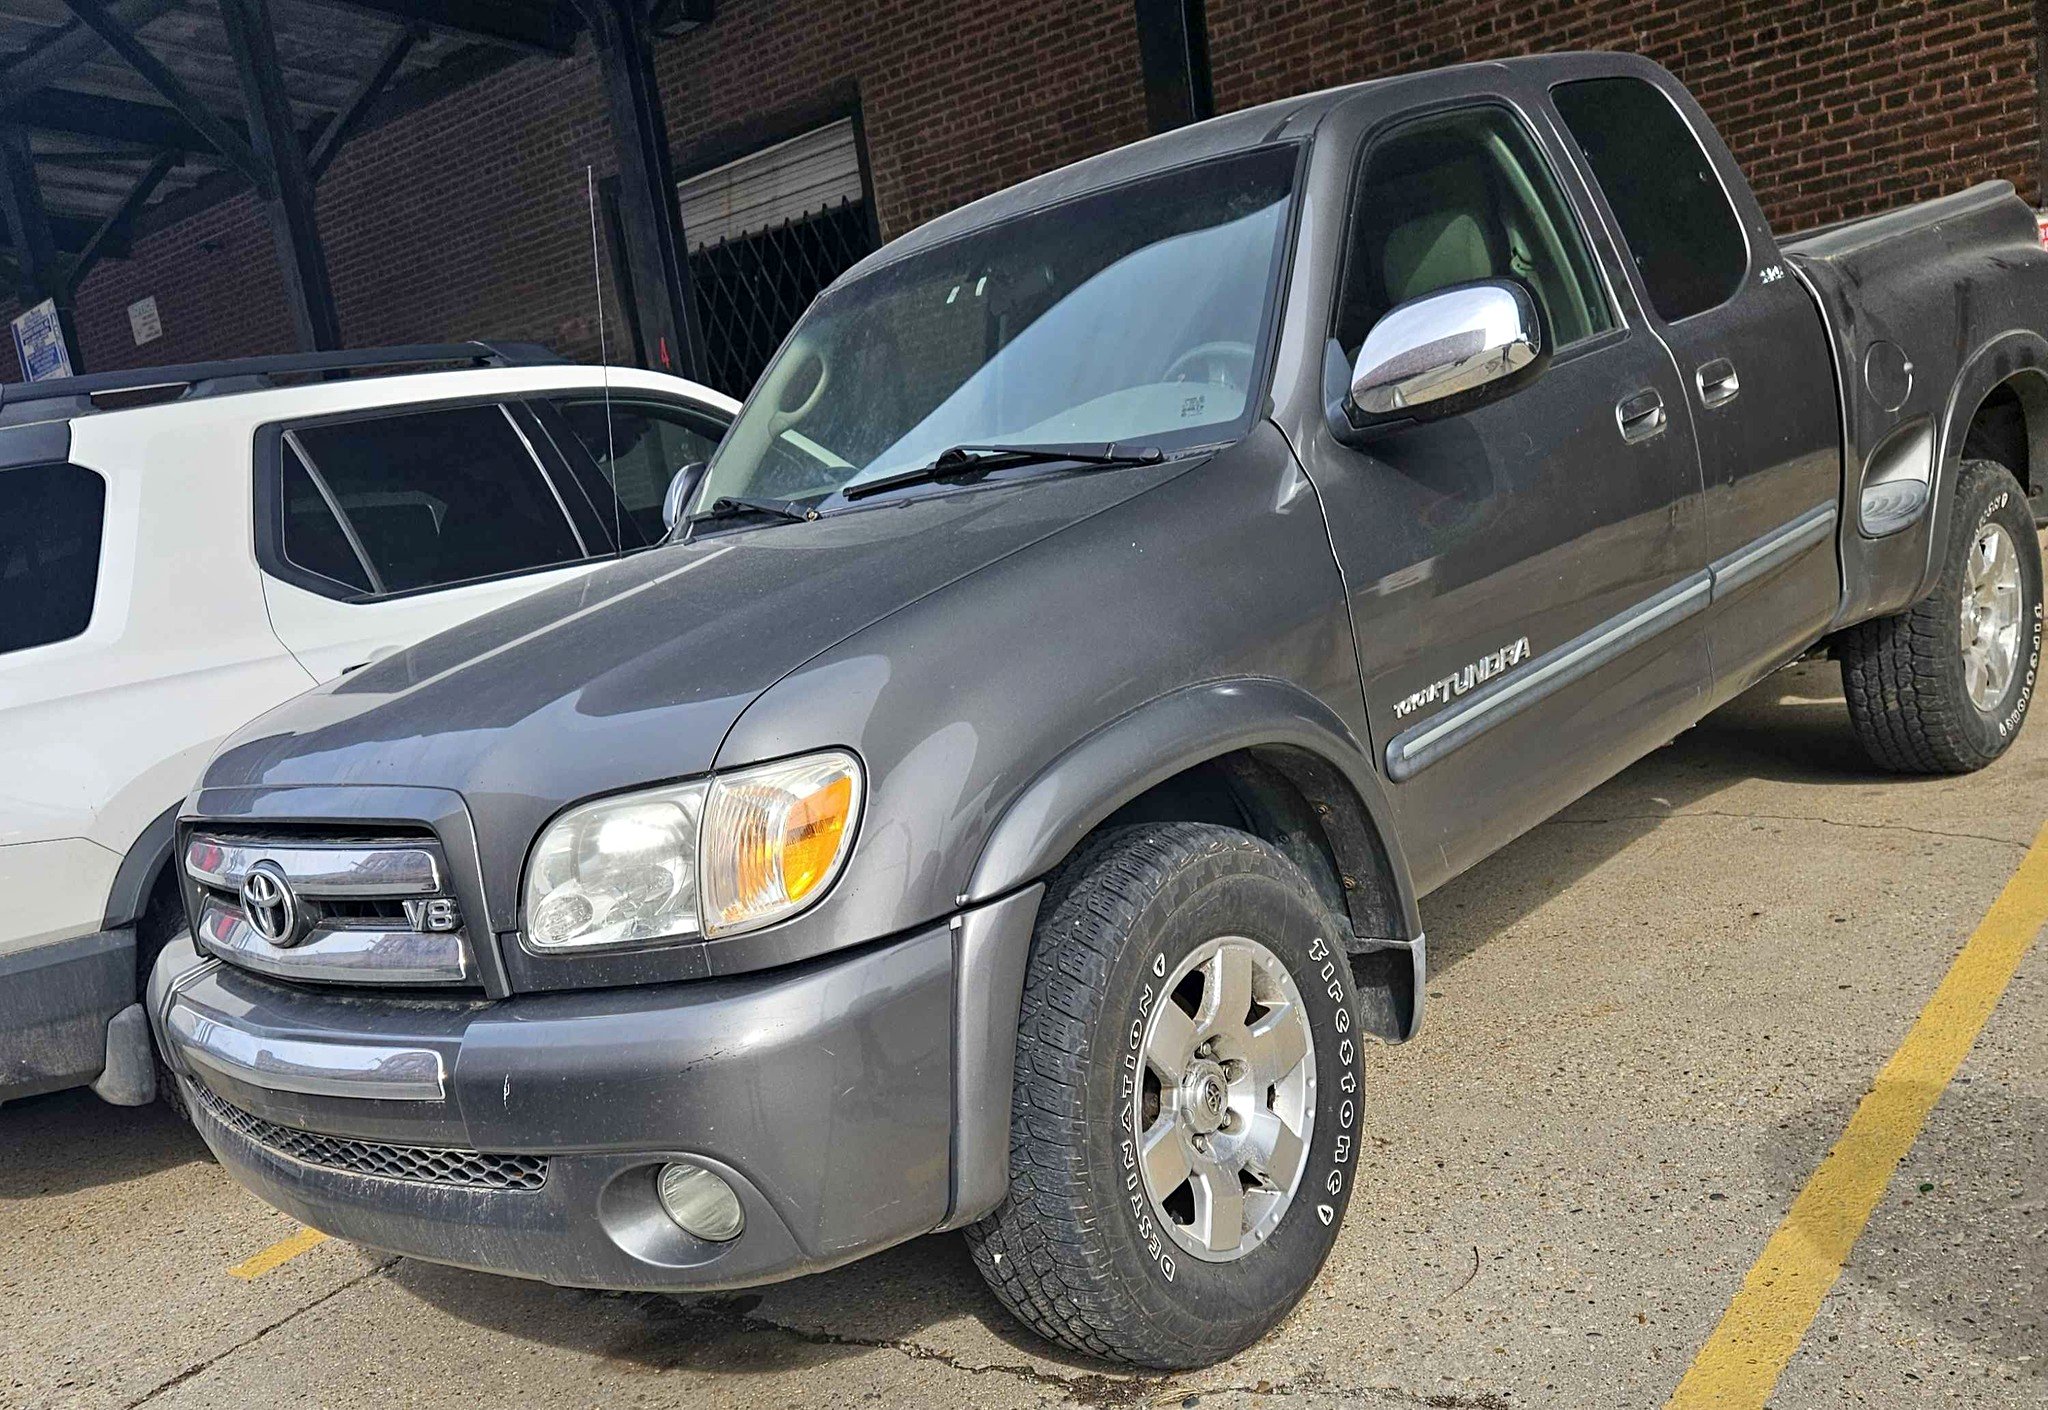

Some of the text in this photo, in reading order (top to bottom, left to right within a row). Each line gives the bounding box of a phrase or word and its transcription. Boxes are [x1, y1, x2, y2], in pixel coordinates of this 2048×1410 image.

[659, 336, 671, 369] 4
[1439, 636, 1531, 703] TUNDRA
[402, 899, 454, 932] V8
[1120, 984, 1176, 1283] DESTINATION
